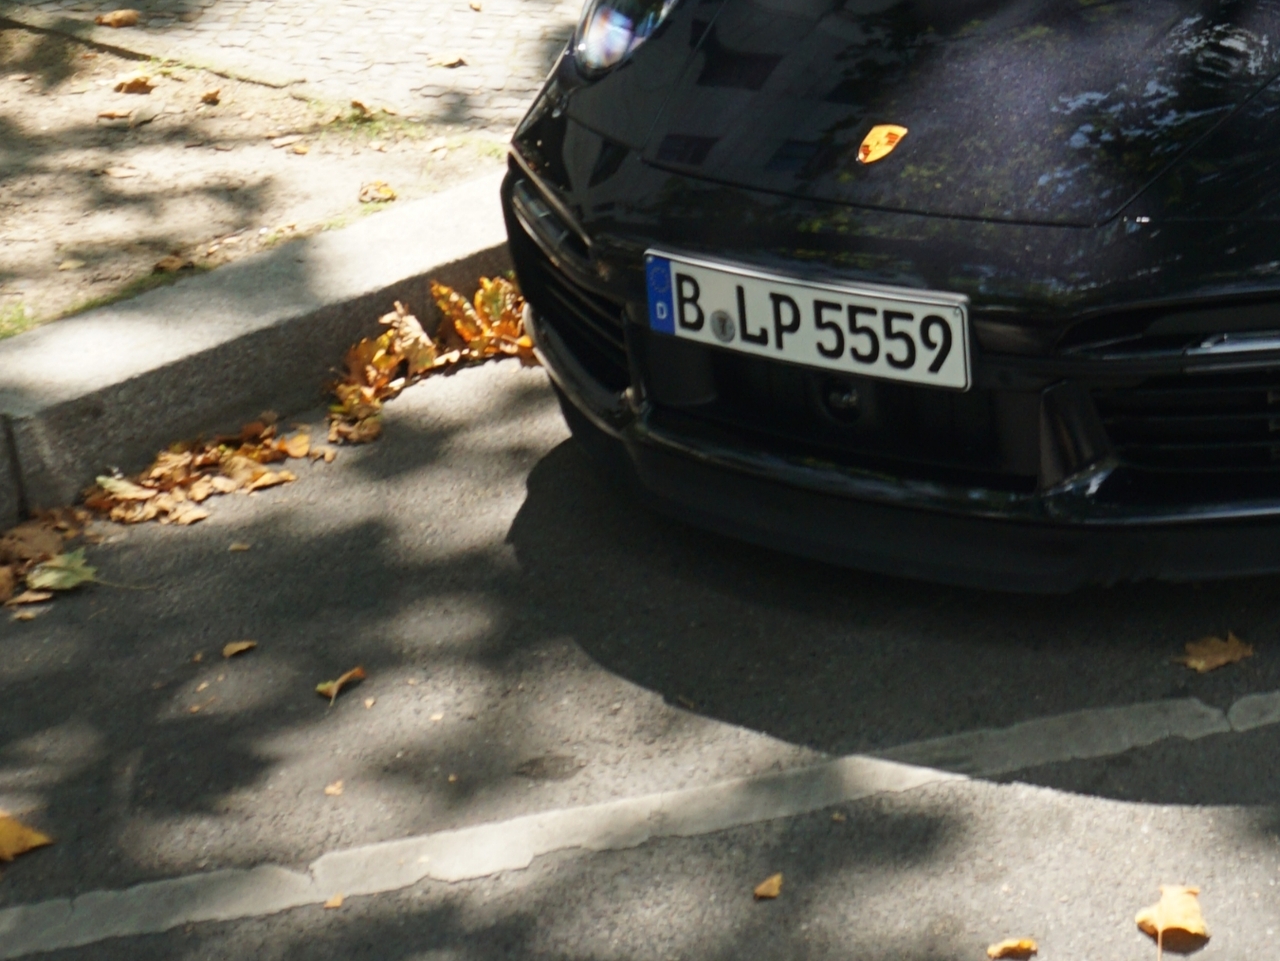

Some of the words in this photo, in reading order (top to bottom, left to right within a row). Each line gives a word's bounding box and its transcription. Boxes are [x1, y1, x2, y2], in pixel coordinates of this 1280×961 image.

[656, 302, 668, 320] D
[676, 273, 705, 331] B
[736, 285, 801, 350] LP
[813, 299, 953, 374] 5559
